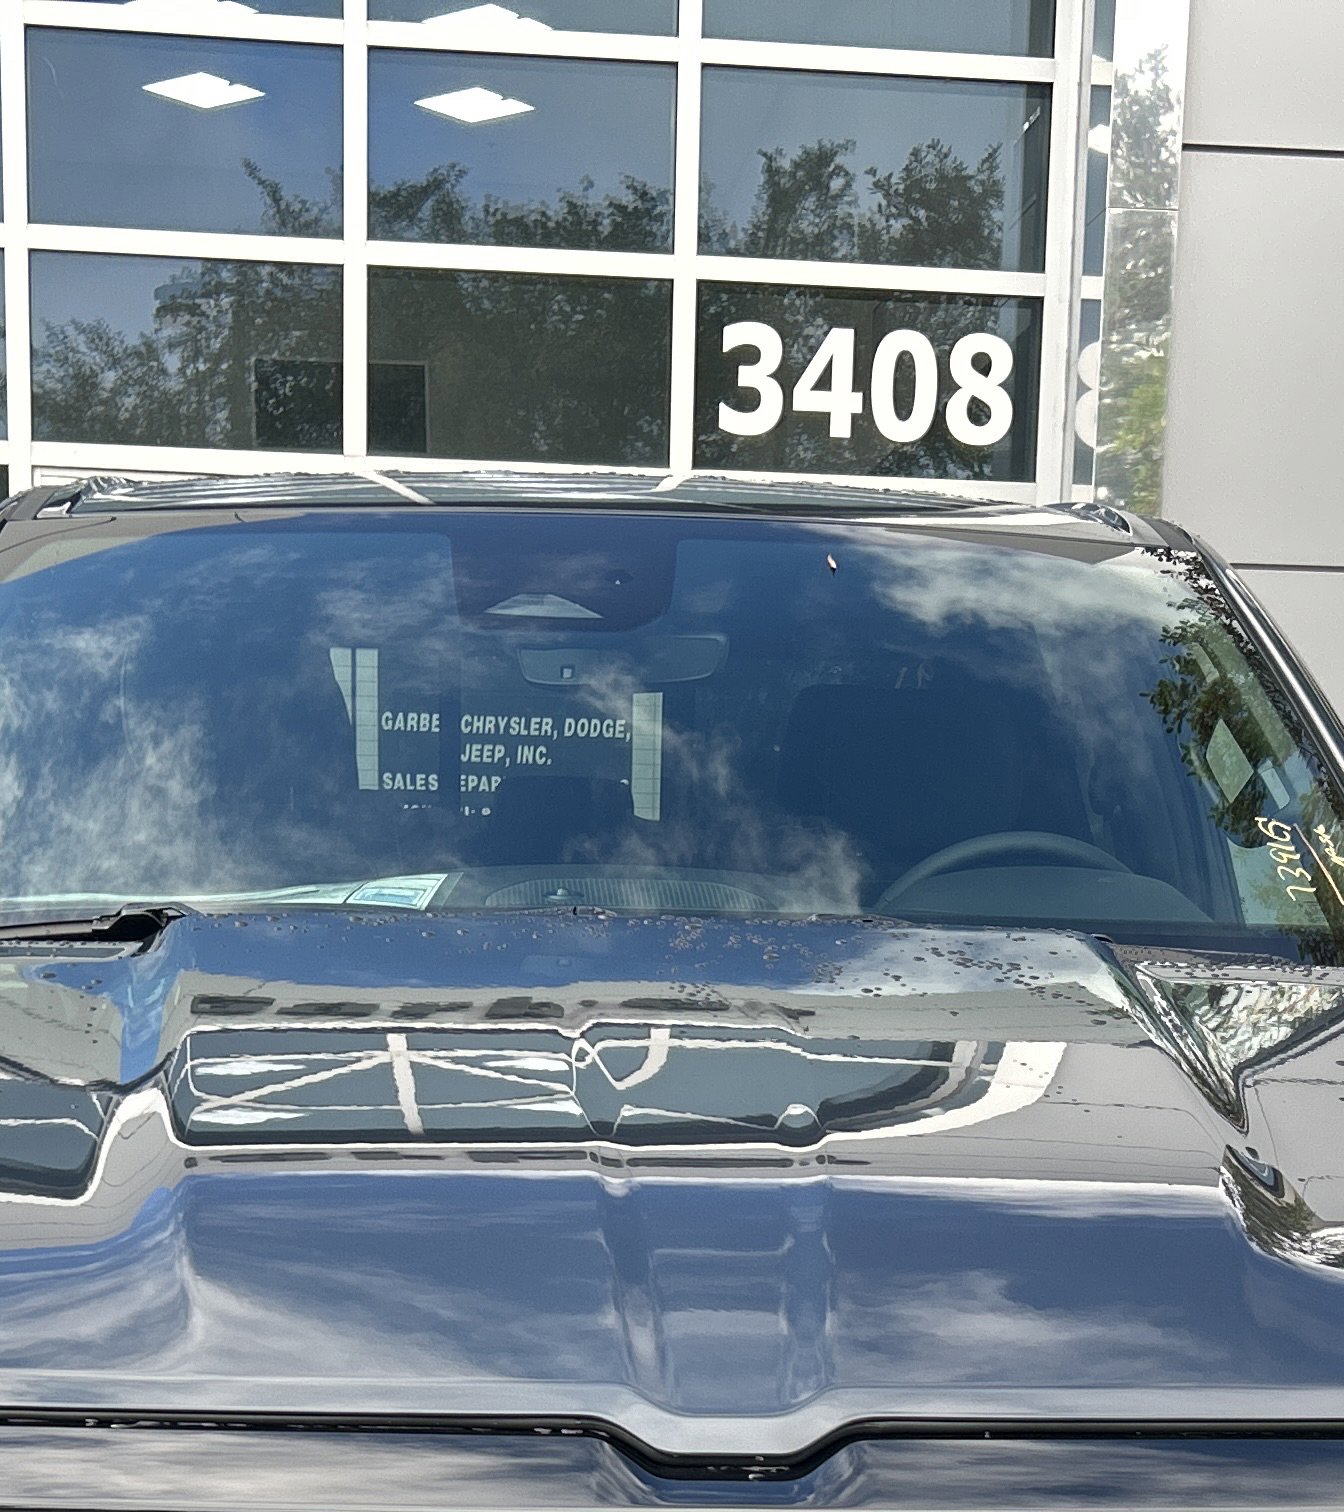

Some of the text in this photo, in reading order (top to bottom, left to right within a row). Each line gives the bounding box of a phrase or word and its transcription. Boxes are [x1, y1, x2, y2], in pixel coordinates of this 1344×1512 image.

[718, 321, 1014, 447] 3408
[381, 711, 631, 743] GARBE CHRYSLER, DODGE,
[460, 743, 552, 768] JEEP, INC.
[382, 772, 439, 791] SALES
